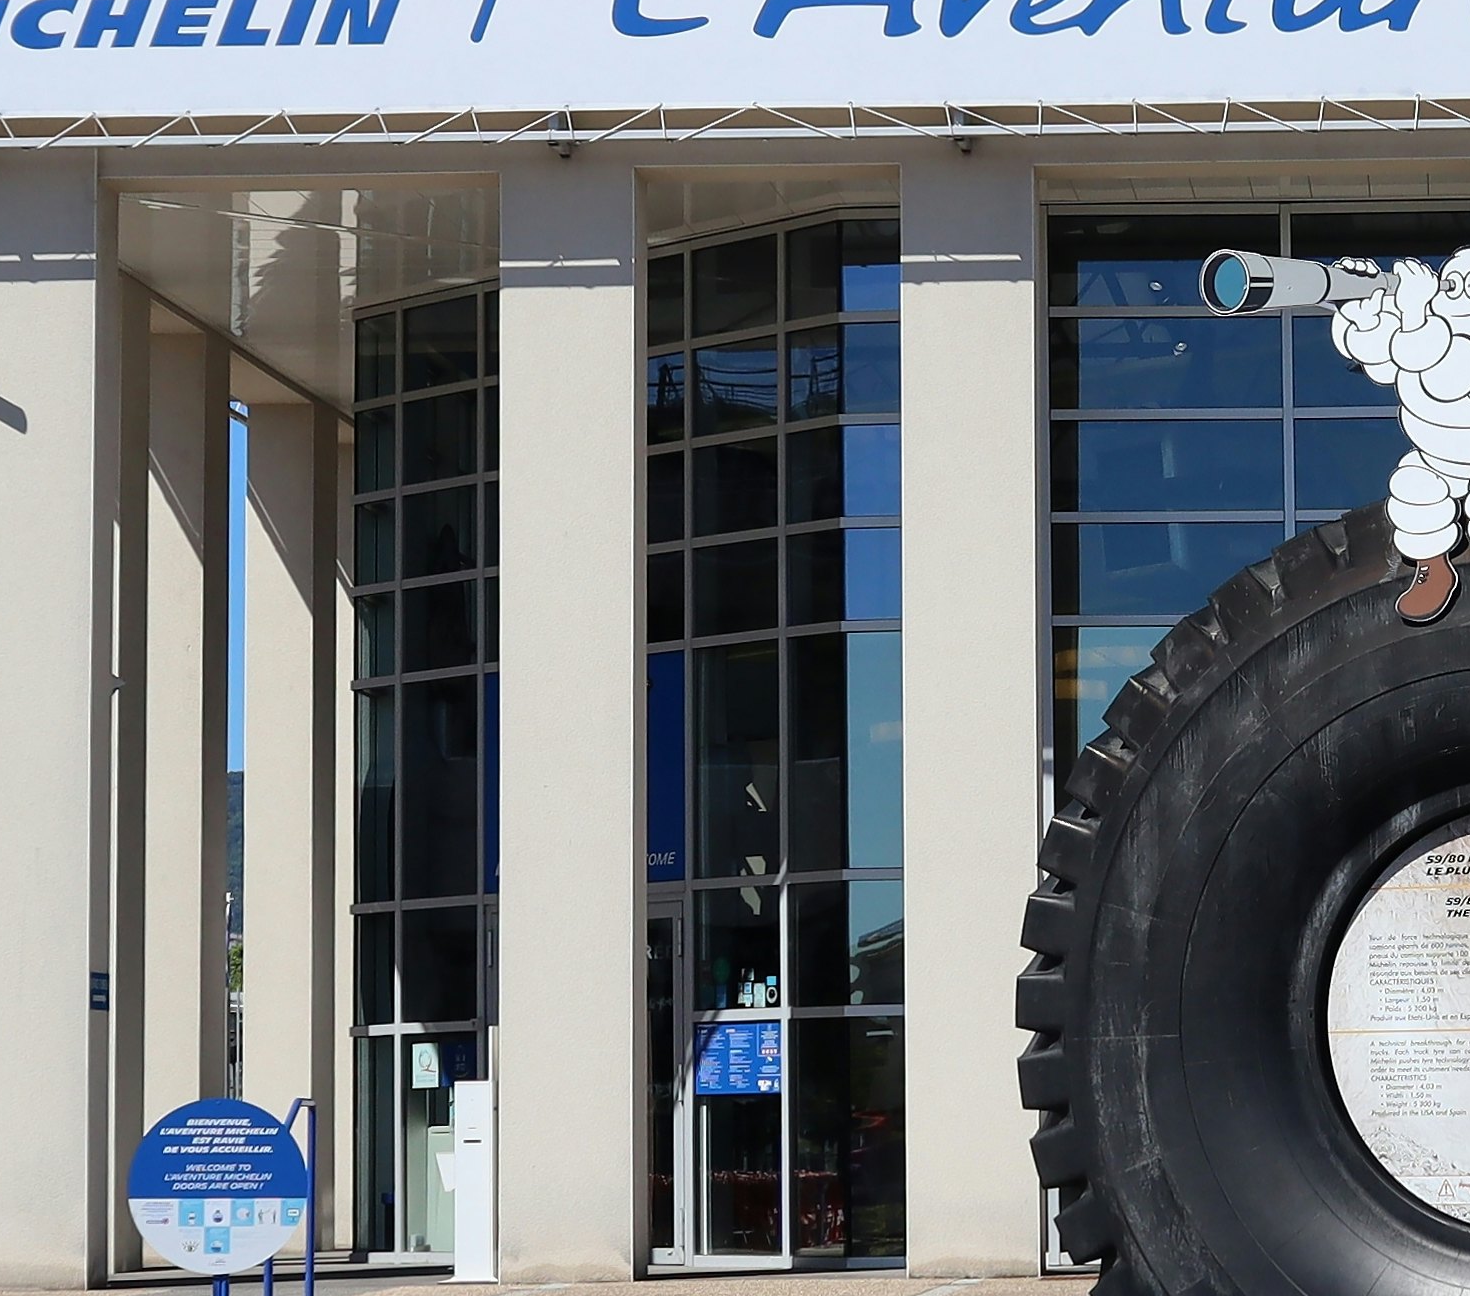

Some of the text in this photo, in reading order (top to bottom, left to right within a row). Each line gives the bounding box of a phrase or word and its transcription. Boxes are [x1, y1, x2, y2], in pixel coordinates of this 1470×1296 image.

[647, 851, 676, 866] OME
[1426, 854, 1465, 864] 59/80
[1426, 867, 1443, 876] LE
[1447, 909, 1470, 918] THE
[186, 1119, 252, 1127] BIENVENUE,
[160, 1128, 224, 1136] L'AVENTURE
[192, 1137, 245, 1145] EST RAVIE
[180, 1146, 209, 1154] VOUS
[185, 1164, 252, 1172] WELCOME TO
[164, 1173, 272, 1181] L'AVENTURE MICHELIN
[172, 1182, 207, 1190] DOORS
[207, 1182, 229, 1190] ARE
[230, 1182, 259, 1190] OPEN
